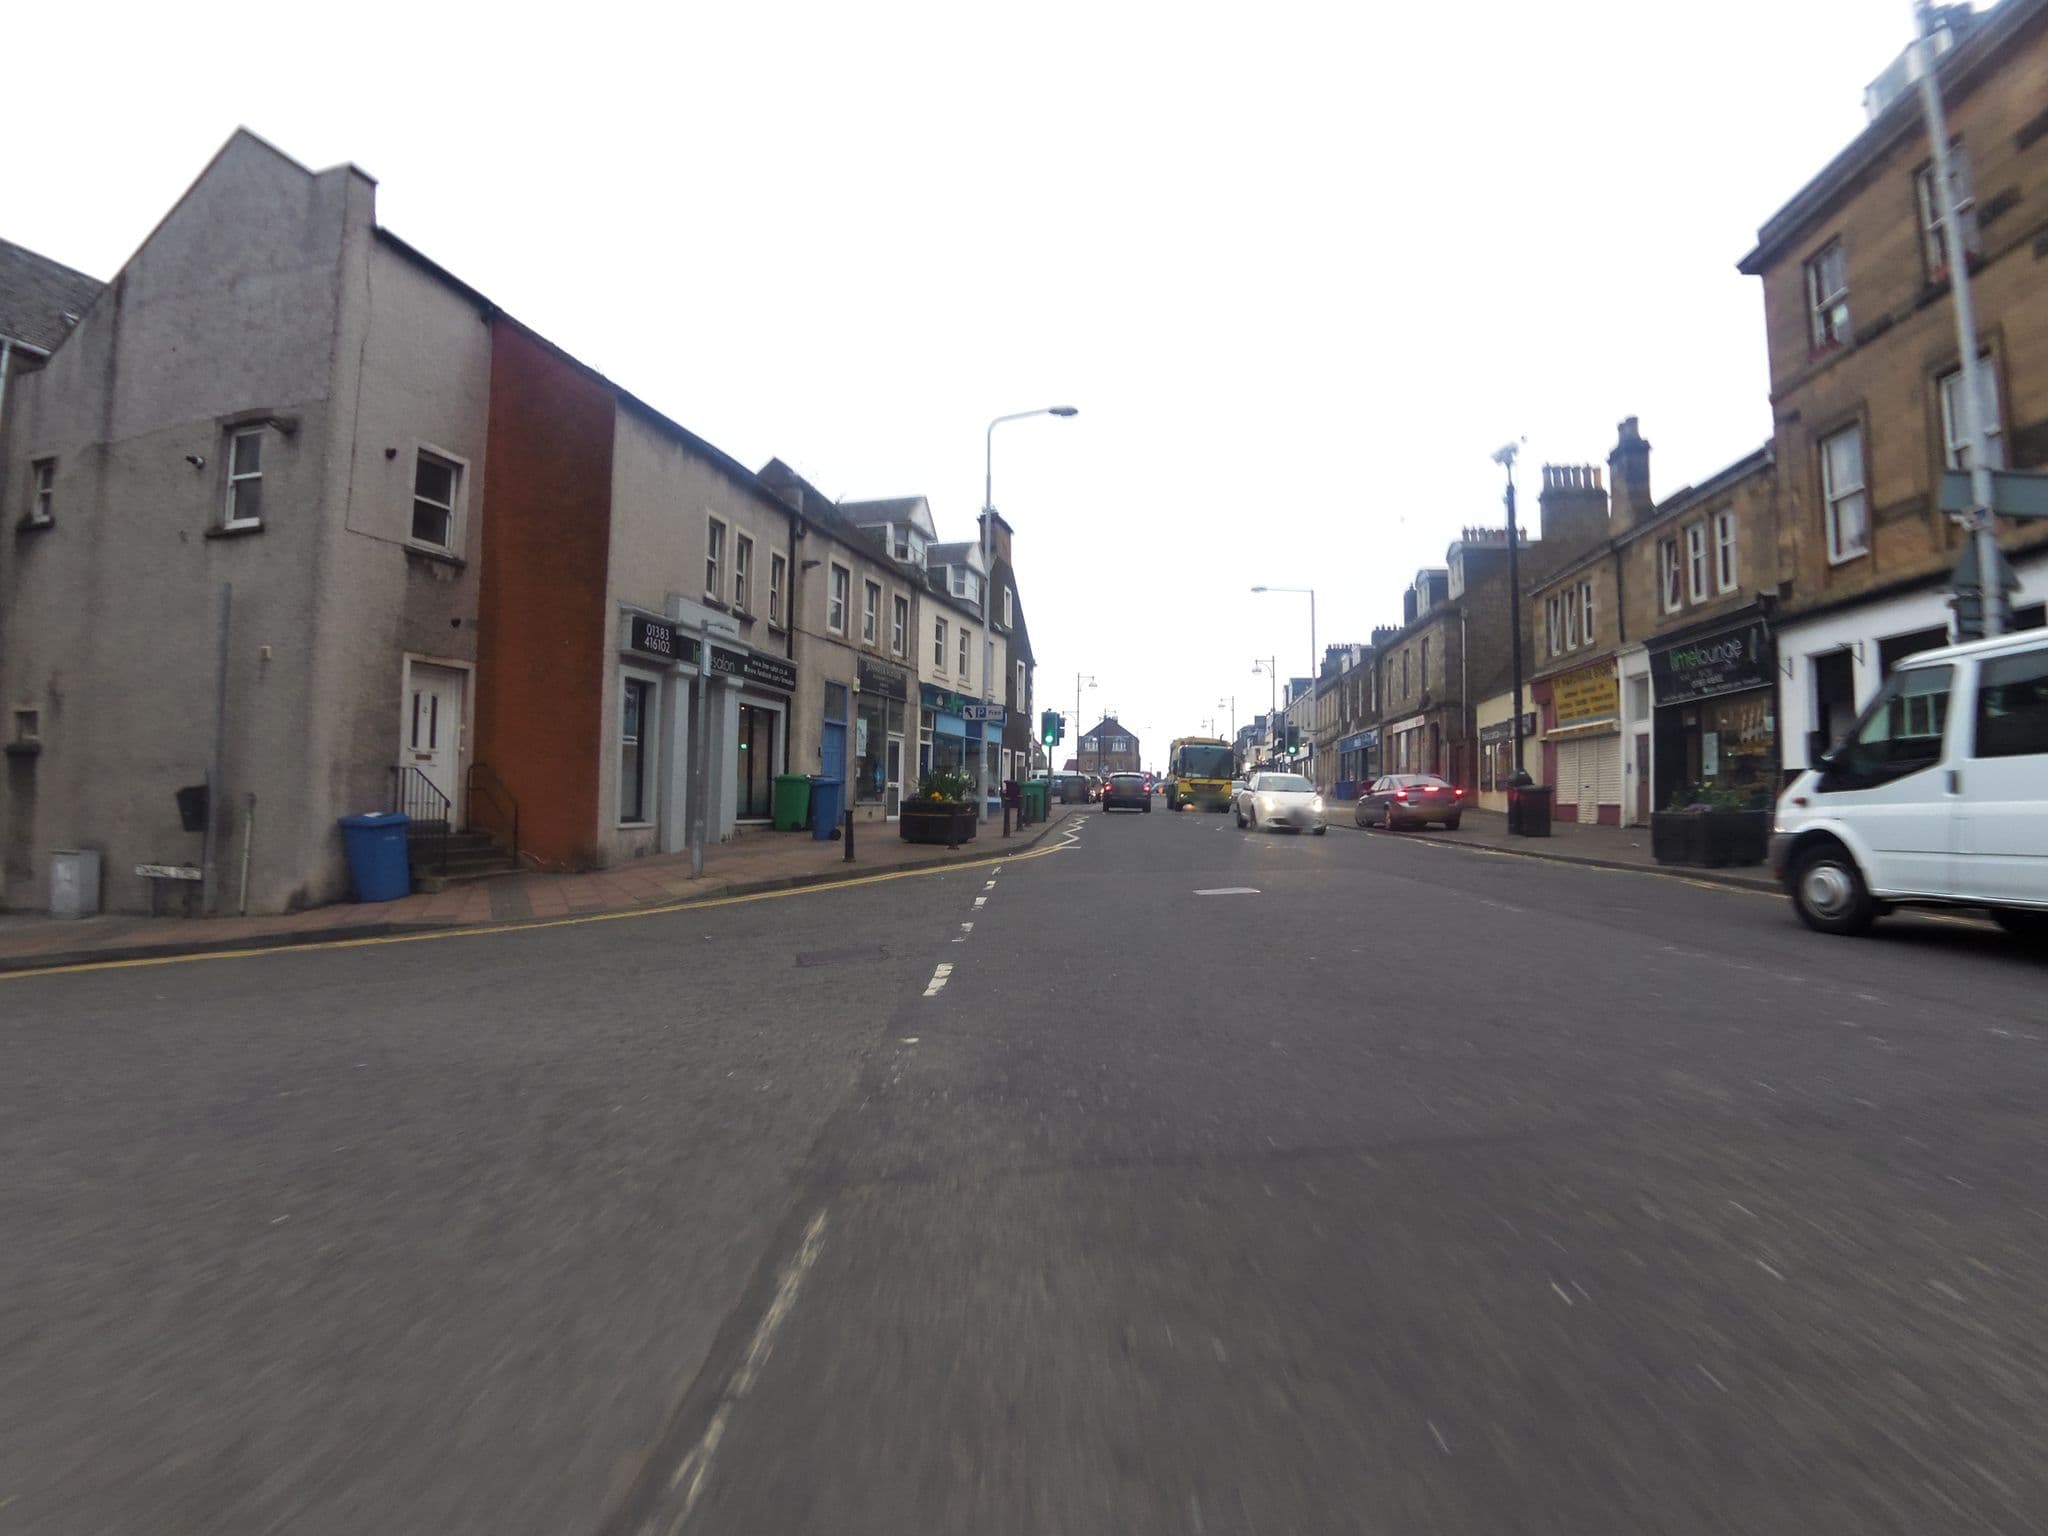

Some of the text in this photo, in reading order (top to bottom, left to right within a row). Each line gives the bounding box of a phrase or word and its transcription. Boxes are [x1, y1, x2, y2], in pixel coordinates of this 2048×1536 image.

[646, 623, 670, 641] 01383
[644, 636, 671, 653] 416102
[713, 654, 735, 672] salon
